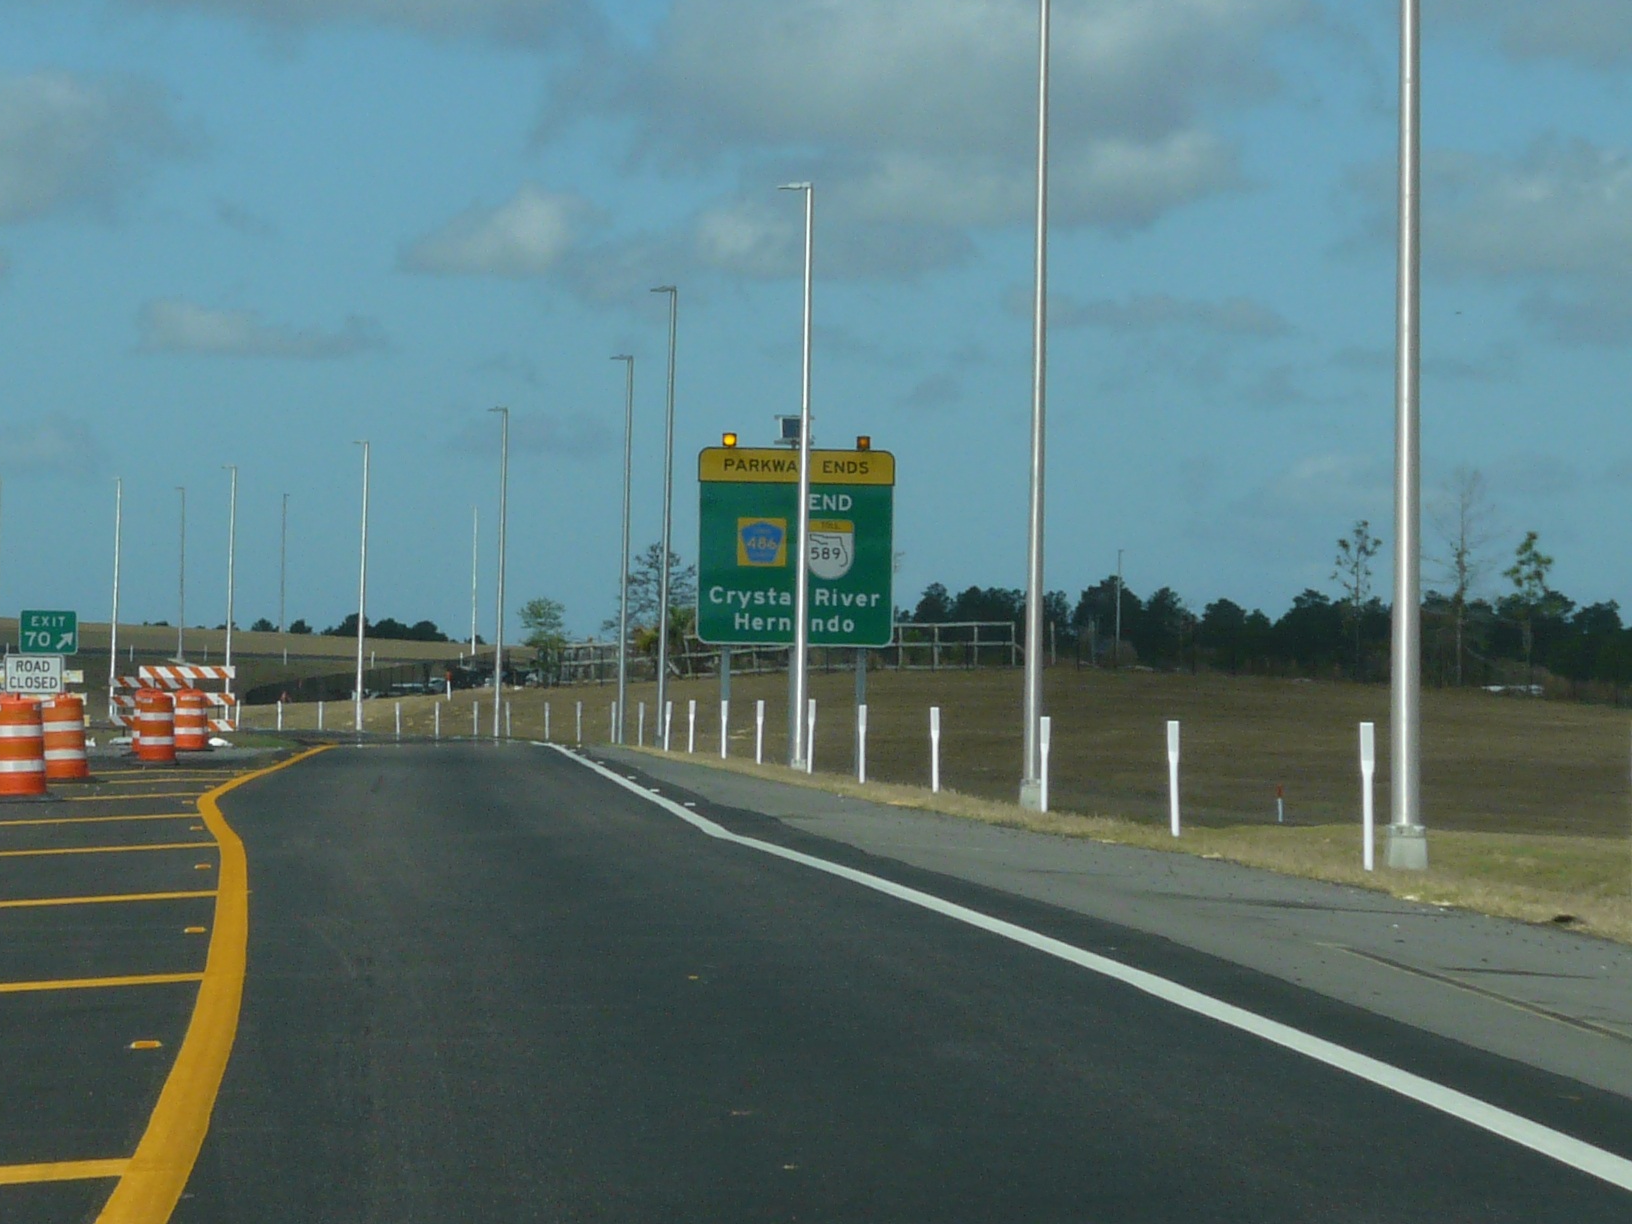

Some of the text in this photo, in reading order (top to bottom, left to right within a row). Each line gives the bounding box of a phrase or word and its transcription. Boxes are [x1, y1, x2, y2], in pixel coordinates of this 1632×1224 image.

[724, 458, 869, 475] PARKWA ENDS
[809, 494, 852, 511] END
[748, 537, 777, 550] 486
[811, 547, 841, 560] 589
[709, 586, 880, 609] Crysta River
[31, 615, 65, 627] EXIT
[734, 613, 855, 633] Hernndo
[25, 631, 51, 647] 70
[15, 660, 50, 673] ROAD
[9, 676, 58, 690] CLOSED
